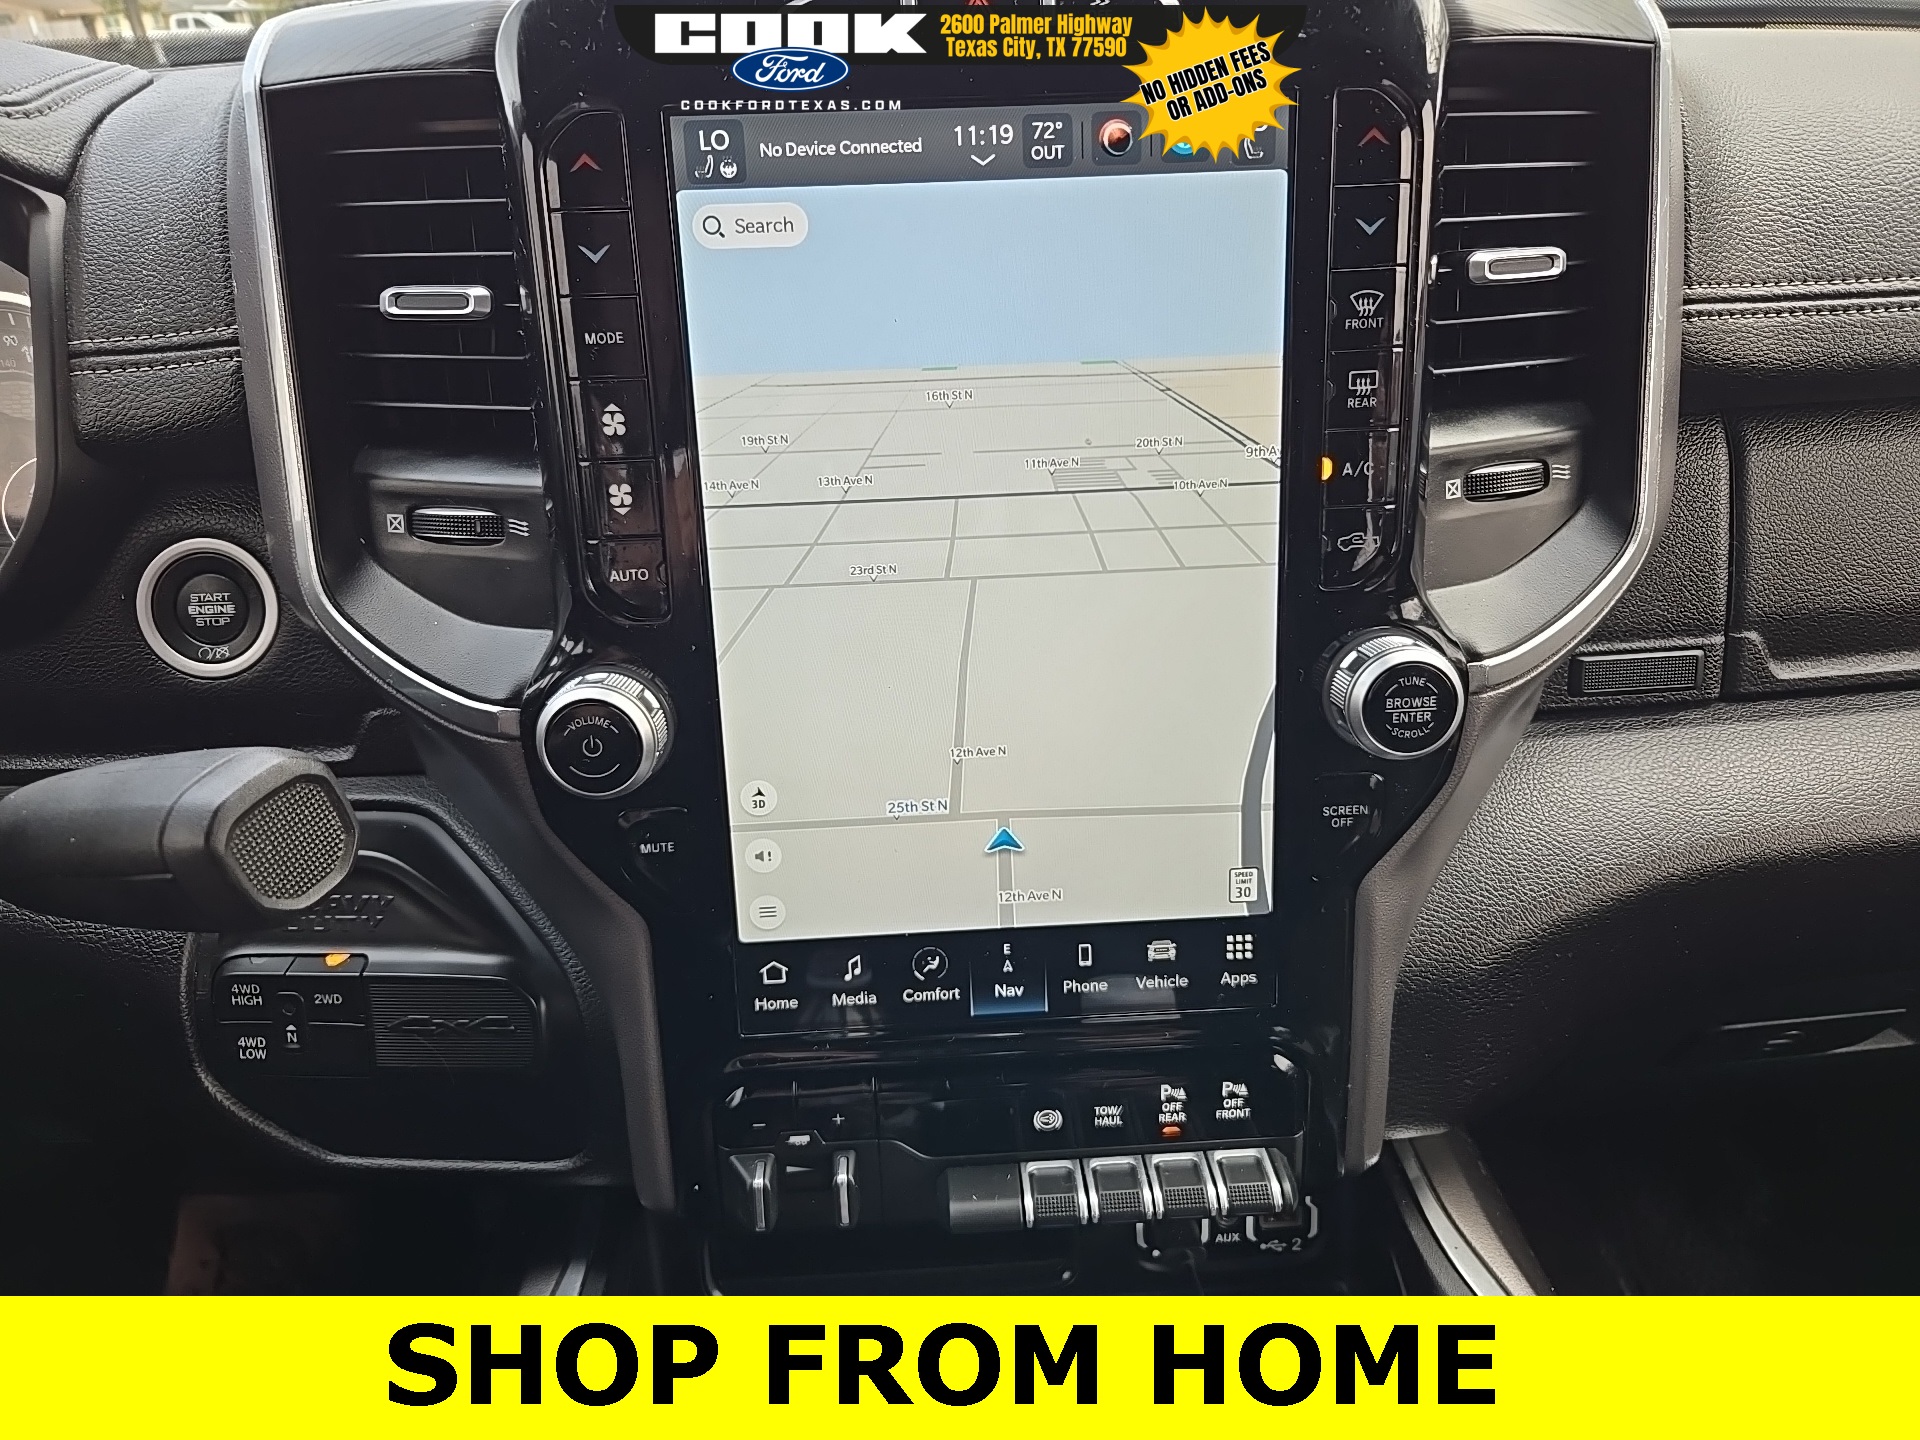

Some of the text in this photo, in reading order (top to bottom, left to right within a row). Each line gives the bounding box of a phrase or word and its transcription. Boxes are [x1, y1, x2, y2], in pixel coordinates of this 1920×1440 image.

[699, 129, 730, 151] LO
[953, 123, 1014, 146] 11:19
[759, 137, 922, 157] No Device Connected
[1031, 145, 1065, 160] OUT
[735, 216, 794, 234] Search
[1345, 317, 1384, 330] FRONT
[3, 335, 18, 347] 90
[584, 332, 625, 345] MODE
[926, 390, 973, 401] 16th St N
[1347, 397, 1377, 409] REAR
[742, 435, 788, 446] 19th St N
[1136, 437, 1183, 448] 20th St N
[1246, 446, 1266, 457] 9th
[1025, 457, 1079, 469] 11th Ave N
[1342, 461, 1375, 477] A/C
[704, 479, 759, 490] 14th Ave N
[818, 475, 873, 486] 13th Ave N
[1174, 479, 1228, 490] 10th Ave N
[609, 568, 649, 583] AUTO
[850, 564, 897, 576] 23rd St N
[190, 592, 231, 604] START
[187, 604, 236, 616] ENGINE
[196, 616, 231, 627] STOP
[1398, 676, 1427, 688] TUNE
[1386, 696, 1437, 709] BROWSE
[568, 716, 611, 731] VOLUME
[1392, 711, 1432, 724] ENTER
[1391, 726, 1430, 739] SCROLL
[951, 746, 1006, 758] 12th Ave N
[752, 799, 766, 809] 3D
[888, 800, 948, 814] 25th St N
[1322, 805, 1369, 817] SCREEN
[1331, 817, 1354, 828] OFF
[639, 842, 675, 854] MUTE
[999, 889, 1062, 903] 12th Ave N
[1235, 886, 1252, 899] 30
[1003, 943, 1011, 955] E
[1135, 973, 1189, 990] Vehicle
[1220, 970, 1258, 988] Apps
[231, 983, 260, 995] 4WD
[994, 983, 1025, 999] Nav
[1063, 977, 1109, 994] Phone
[314, 993, 343, 1005] 2WD
[832, 990, 877, 1007] Media
[902, 985, 961, 1003] Comfort
[231, 994, 263, 1007] HIGH
[755, 995, 799, 1012] Home
[238, 1036, 266, 1049] 4WD
[287, 1032, 298, 1044] N
[239, 1048, 267, 1060] LOW
[1162, 1102, 1183, 1113] OFF
[1223, 1098, 1245, 1109] OFF
[1094, 1105, 1123, 1116] TOW/
[1216, 1108, 1251, 1121] FRONT
[1094, 1116, 1124, 1128] HAUL
[1158, 1113, 1187, 1124] REAR
[1214, 1233, 1241, 1244] AUX
[1291, 1237, 1303, 1252] 2
